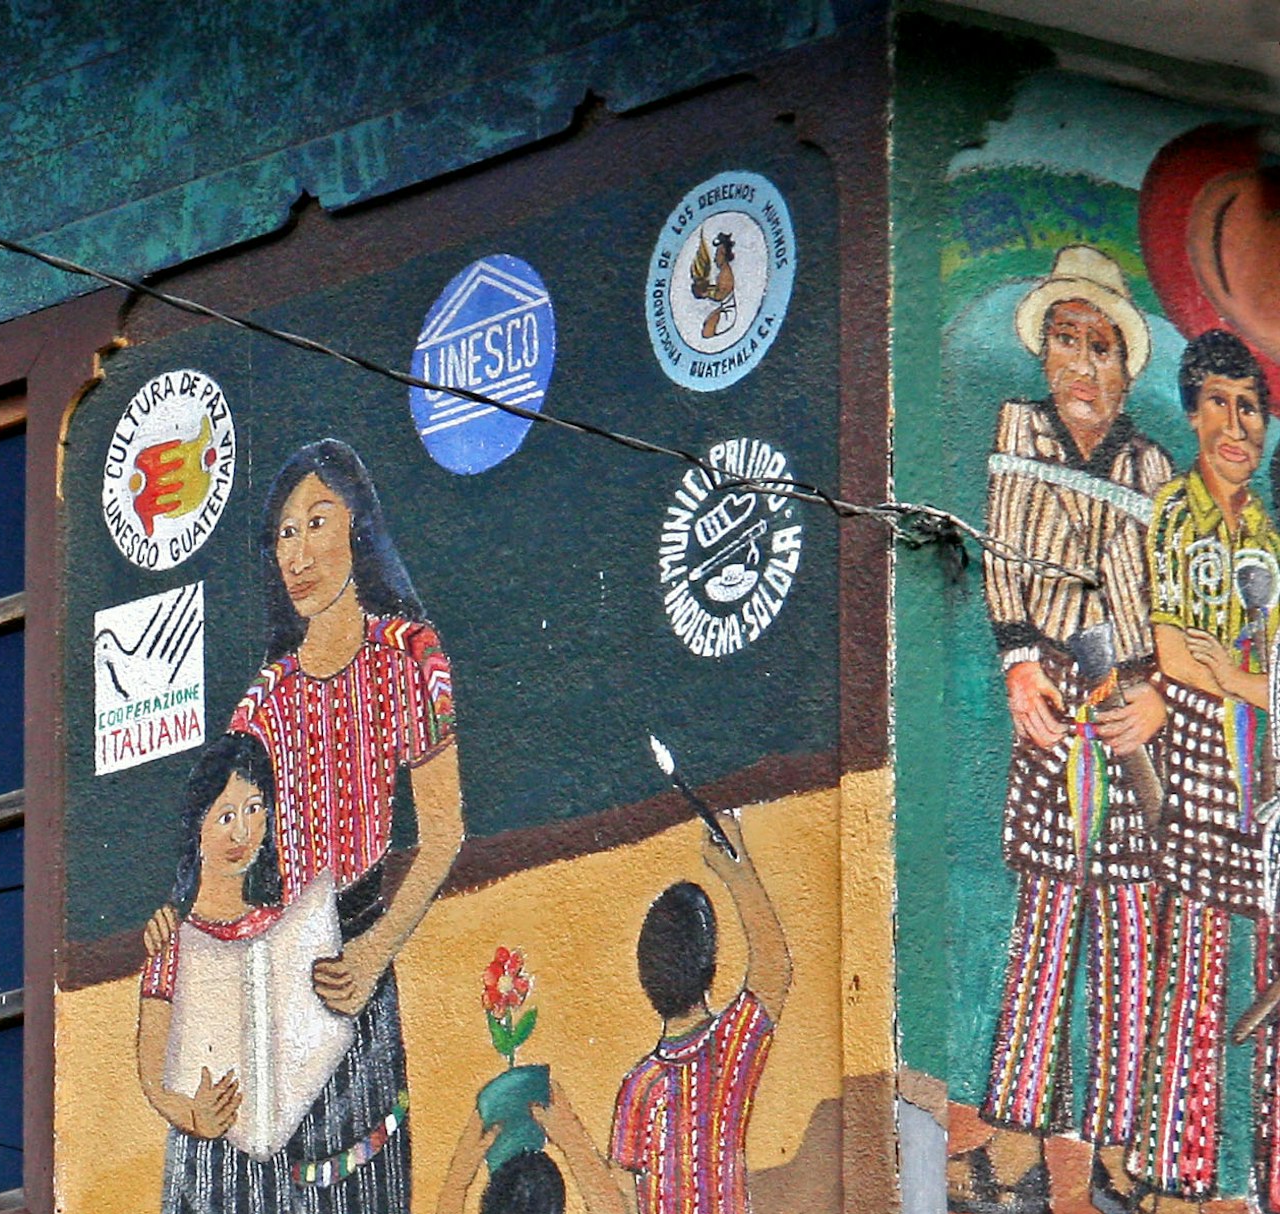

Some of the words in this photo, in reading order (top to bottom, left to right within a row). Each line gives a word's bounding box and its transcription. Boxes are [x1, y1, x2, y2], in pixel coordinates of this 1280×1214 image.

[658, 250, 672, 269] DE
[671, 205, 694, 235] LOS
[698, 183, 756, 210] DERECHOS
[761, 200, 788, 270] HUMANOS
[423, 311, 540, 401] UNESCO
[689, 337, 759, 378] GUATEMALA
[106, 374, 176, 480] CULTURA
[179, 372, 201, 398] DE
[200, 382, 228, 430] PAZ
[105, 496, 160, 568] UNESCO
[168, 429, 236, 562] GUATEMALA
[664, 579, 743, 658] INDIGENA
[742, 525, 803, 643] SOLOLA
[98, 682, 200, 731] COOPERAZIONE
[101, 707, 202, 766] ITALIANA
